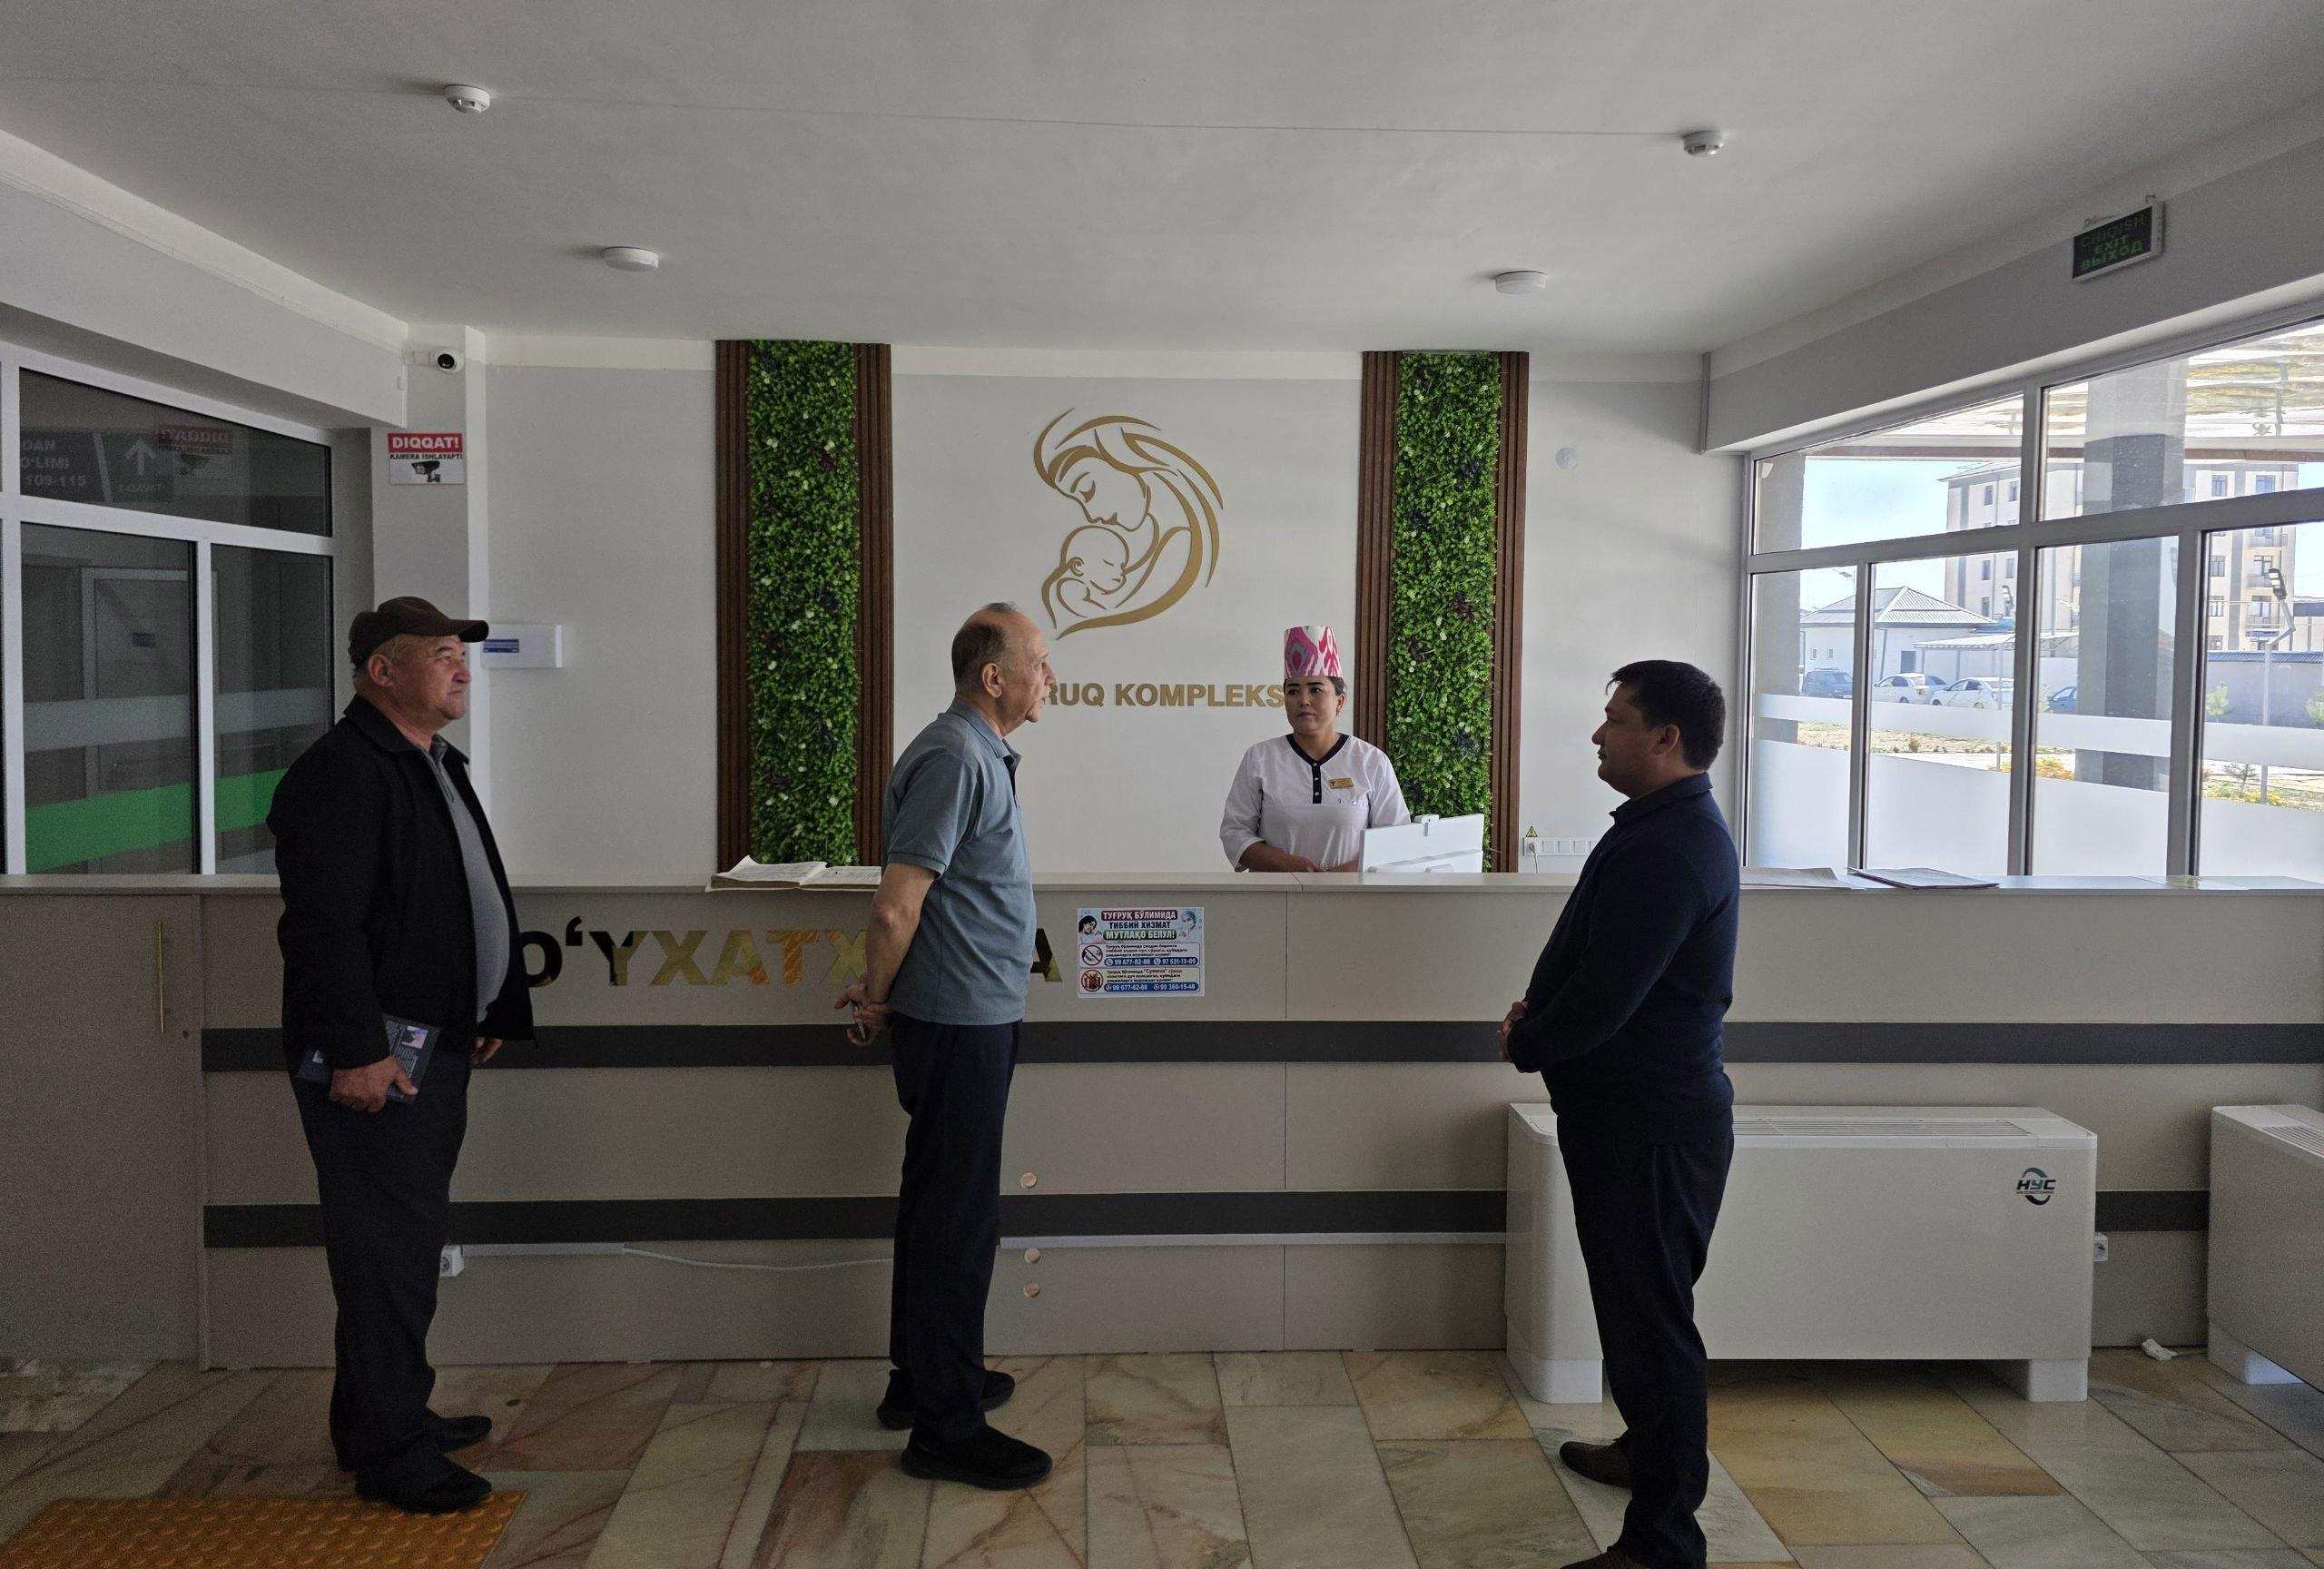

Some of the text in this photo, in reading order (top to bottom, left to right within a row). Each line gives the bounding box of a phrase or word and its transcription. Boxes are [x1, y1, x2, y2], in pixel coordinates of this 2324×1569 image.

[2094, 234, 2130, 254] EXIT
[2081, 240, 2142, 271] ВЫХОД
[392, 437, 459, 449] DIQQAT!
[1049, 683, 1285, 707] RUQ KOMPLEKS
[1109, 920, 1138, 929] ТИББИЙ
[1147, 931, 1175, 939] БЕПУЛ!
